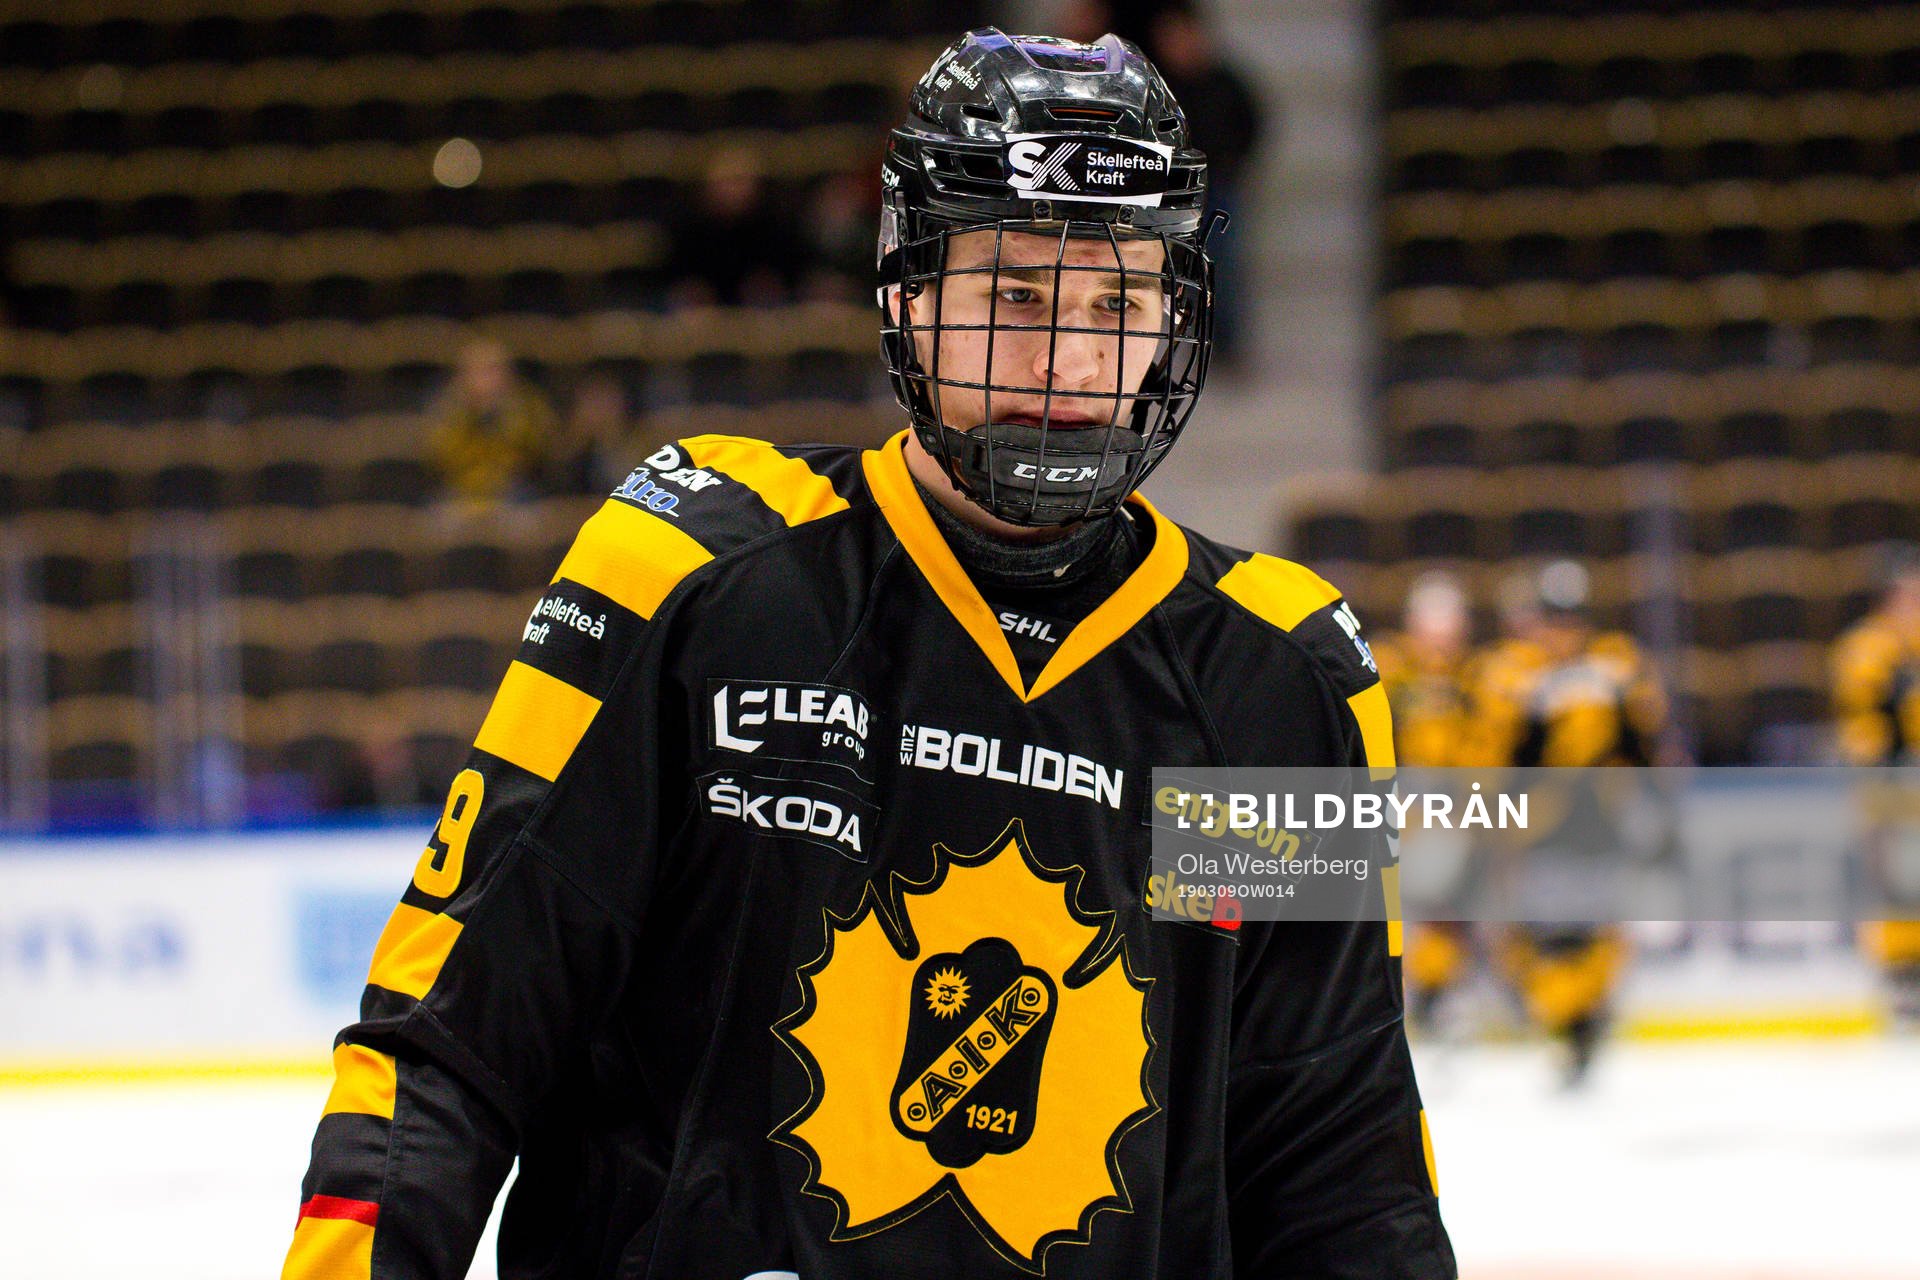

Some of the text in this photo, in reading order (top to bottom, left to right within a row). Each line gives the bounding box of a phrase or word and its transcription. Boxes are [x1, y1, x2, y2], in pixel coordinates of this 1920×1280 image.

[1087, 152, 1164, 171] Skellefteå
[1086, 170, 1126, 186] Kraft
[1012, 462, 1106, 482] CCM
[999, 612, 1057, 643] SHL
[773, 687, 869, 741] LEAB
[821, 731, 865, 761] group
[914, 726, 1124, 810] BOLIDEN
[708, 777, 863, 853] ŠKODA
[965, 1104, 1019, 1135] 1921
